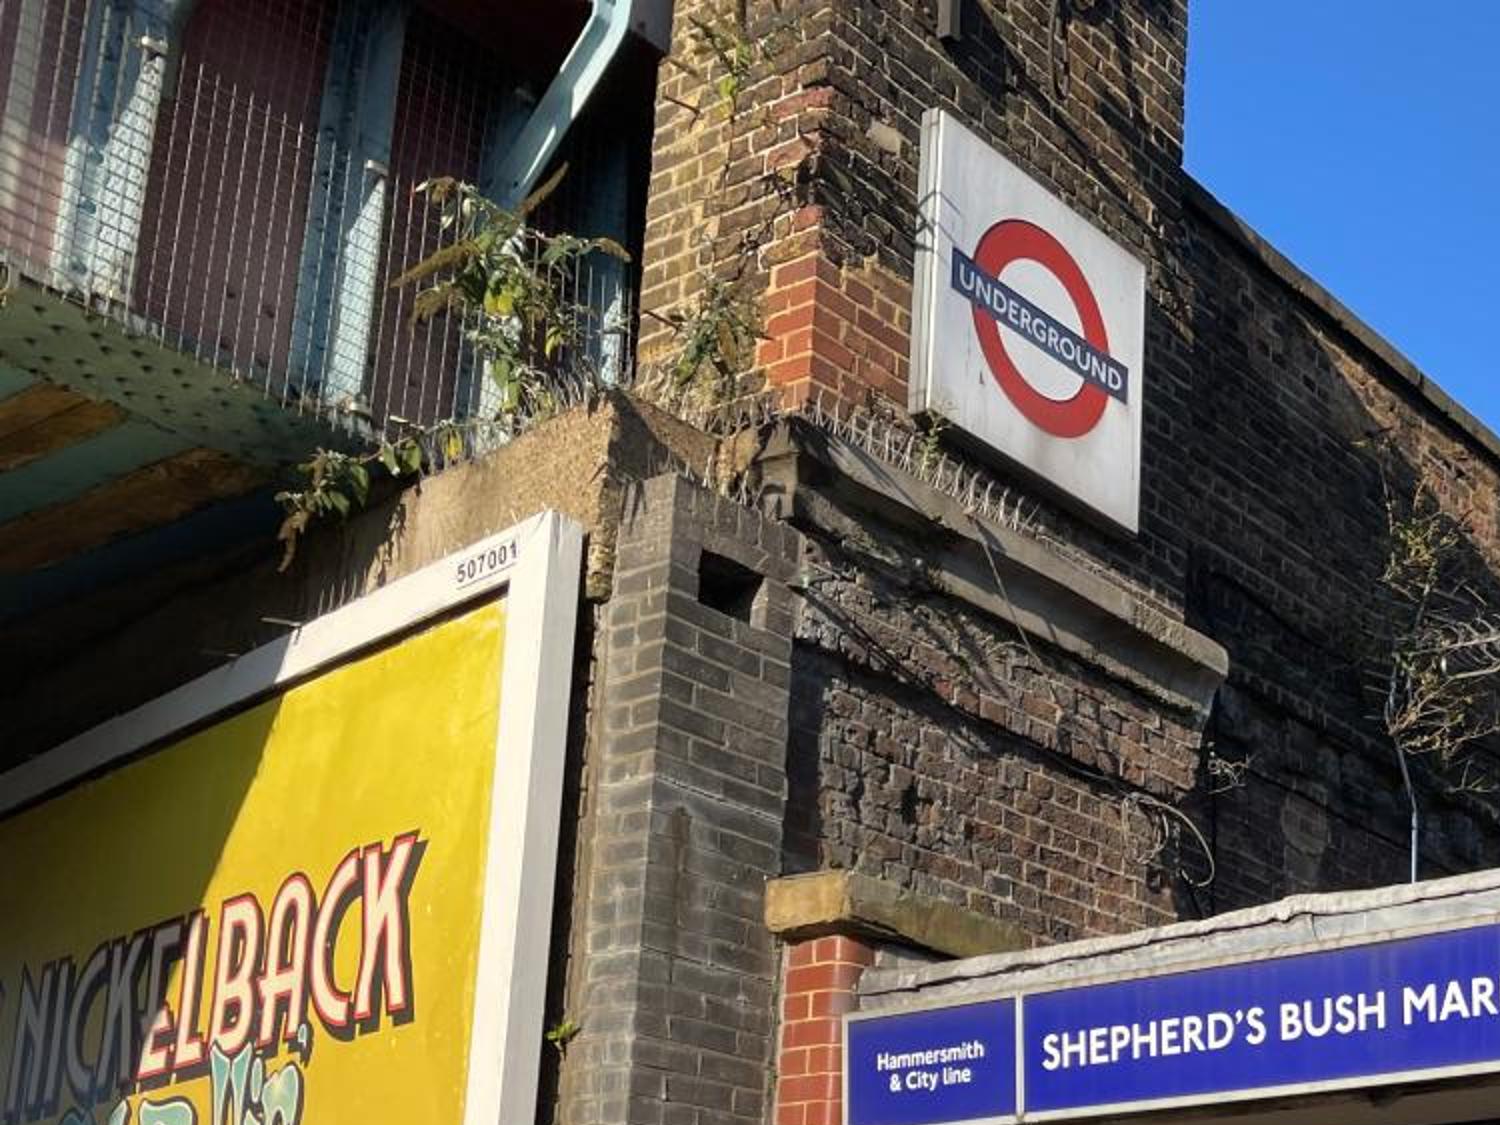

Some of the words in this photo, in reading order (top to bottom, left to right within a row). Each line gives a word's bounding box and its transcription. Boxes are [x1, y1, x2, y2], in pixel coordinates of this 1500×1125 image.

[959, 263, 1122, 391] UNDERGROUND
[456, 540, 517, 583] 507001
[5, 829, 428, 1125] NICKELBACK
[877, 1039, 985, 1072] Hammersmith
[1042, 1007, 1267, 1071] SHEPHERD'S
[1280, 991, 1385, 1041] BUSH
[889, 1073, 902, 1092] &
[905, 1068, 938, 1091] City
[942, 1066, 971, 1086] line
